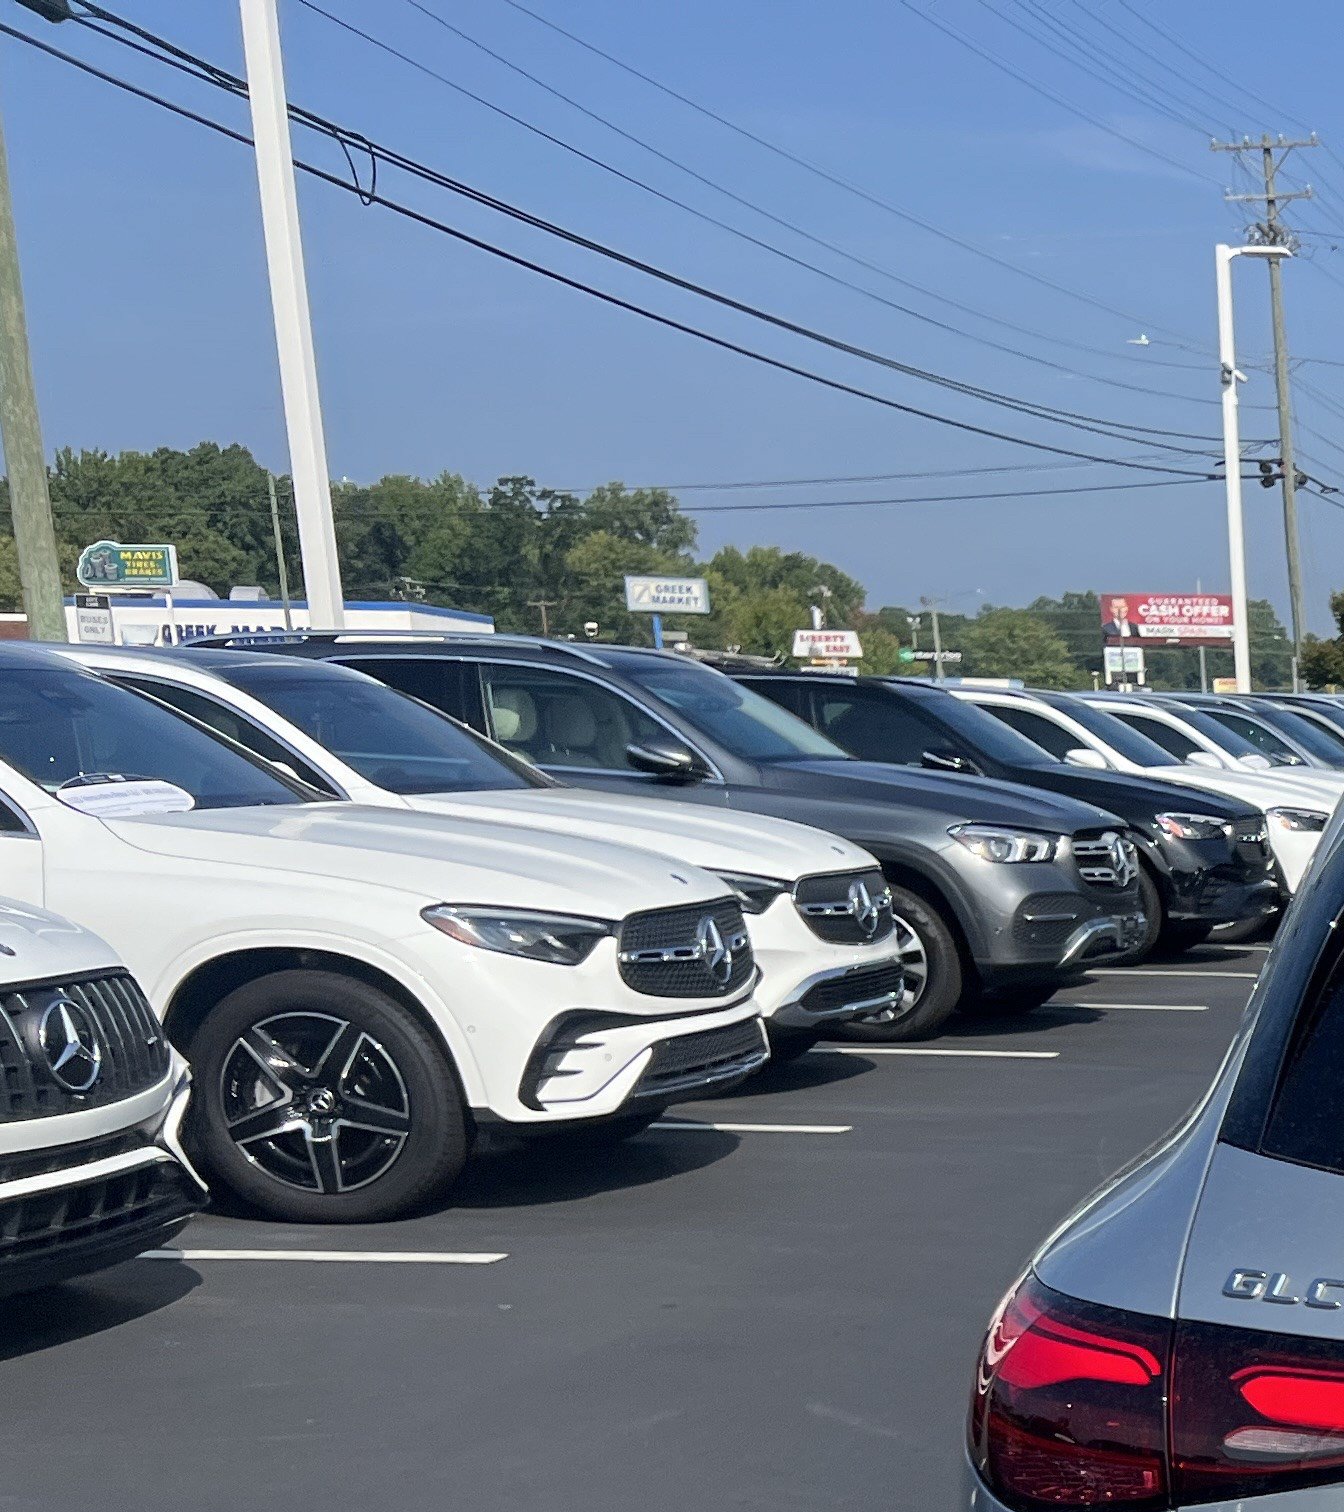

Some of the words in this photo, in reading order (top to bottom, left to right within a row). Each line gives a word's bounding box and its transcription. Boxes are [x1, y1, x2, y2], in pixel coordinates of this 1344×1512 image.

[120, 551, 163, 560] MAVIS
[655, 584, 692, 594] GREEK
[651, 595, 699, 606] MARKET
[1147, 597, 1218, 606] GUARANTEED
[1138, 604, 1180, 616] CASH
[1182, 605, 1230, 617] OFFER
[80, 615, 109, 625] BUSES
[84, 625, 106, 635] ONLY
